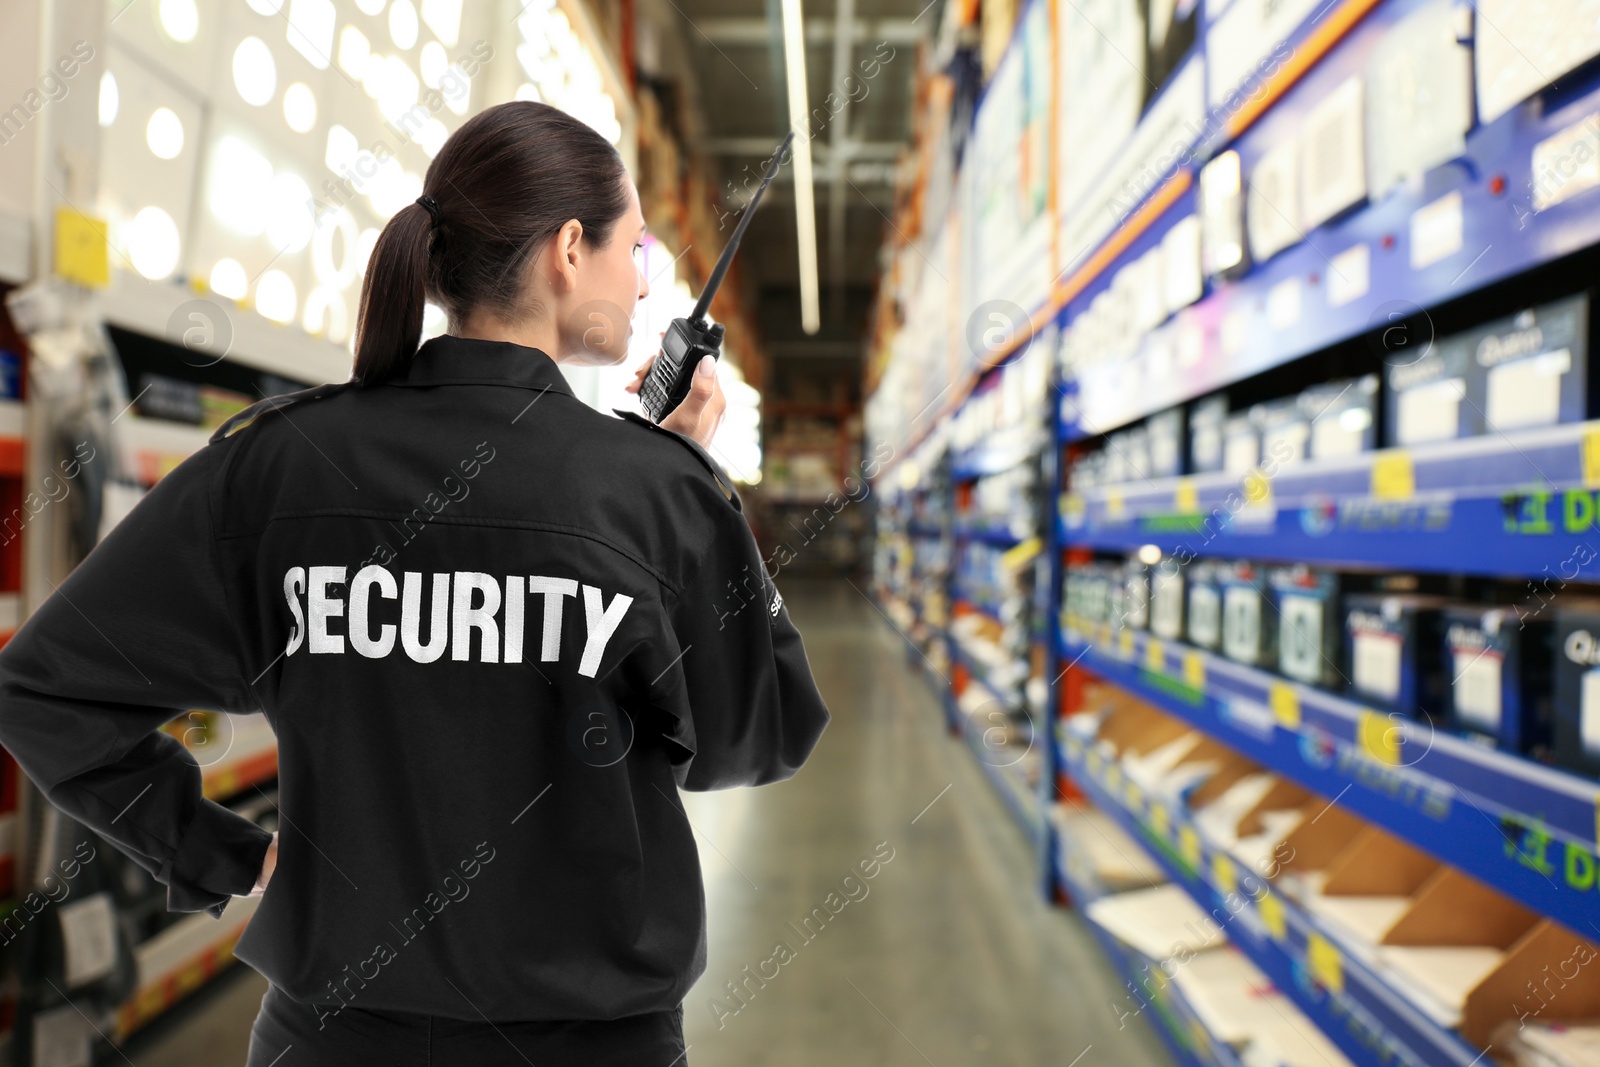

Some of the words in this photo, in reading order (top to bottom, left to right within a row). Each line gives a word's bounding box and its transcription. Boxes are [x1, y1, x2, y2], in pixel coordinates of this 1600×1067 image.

[1563, 489, 1600, 534] D
[283, 564, 634, 679] SECURITY
[1564, 840, 1600, 892] D
